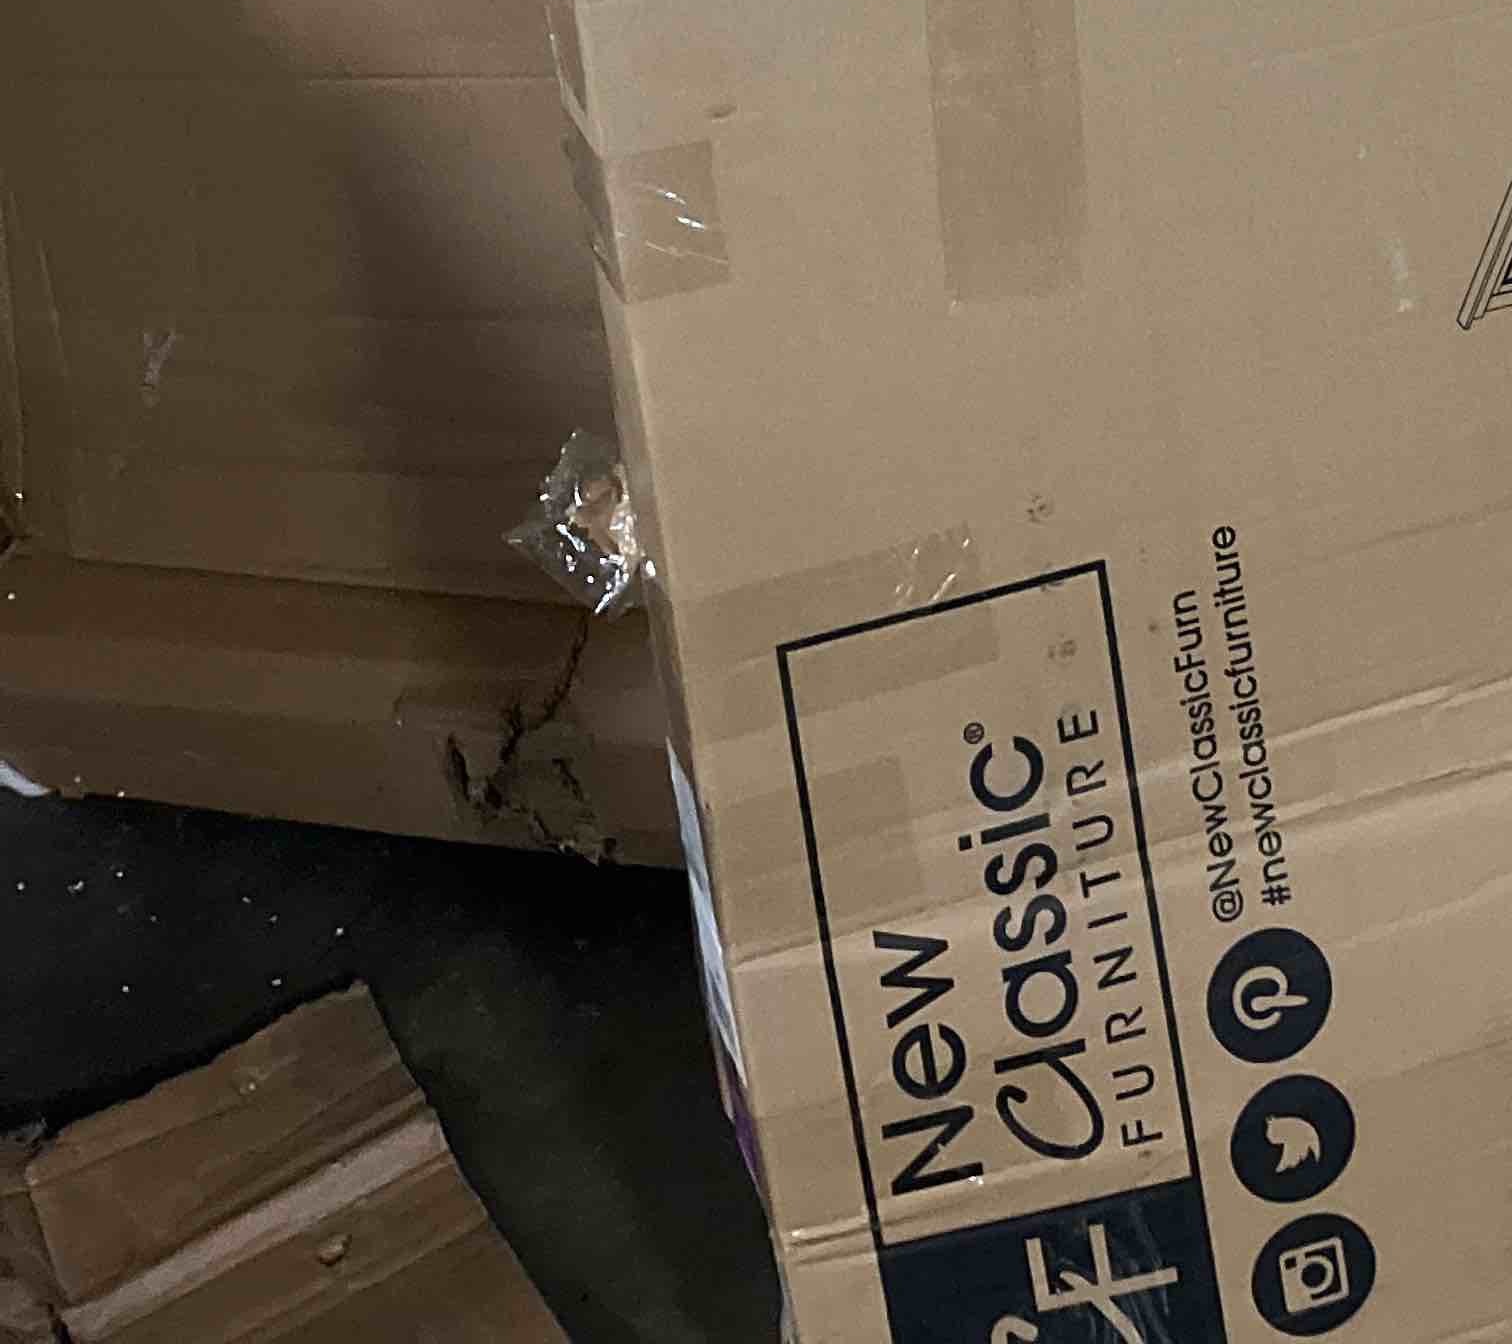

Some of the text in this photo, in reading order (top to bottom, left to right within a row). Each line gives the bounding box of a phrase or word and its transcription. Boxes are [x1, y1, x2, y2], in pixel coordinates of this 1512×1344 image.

[1169, 591, 1243, 922] @NewClassicFurn
[1210, 525, 1292, 906] #newclassicfurniture
[873, 931, 983, 1195] New
[1058, 709, 1163, 1145] FURNITURE
